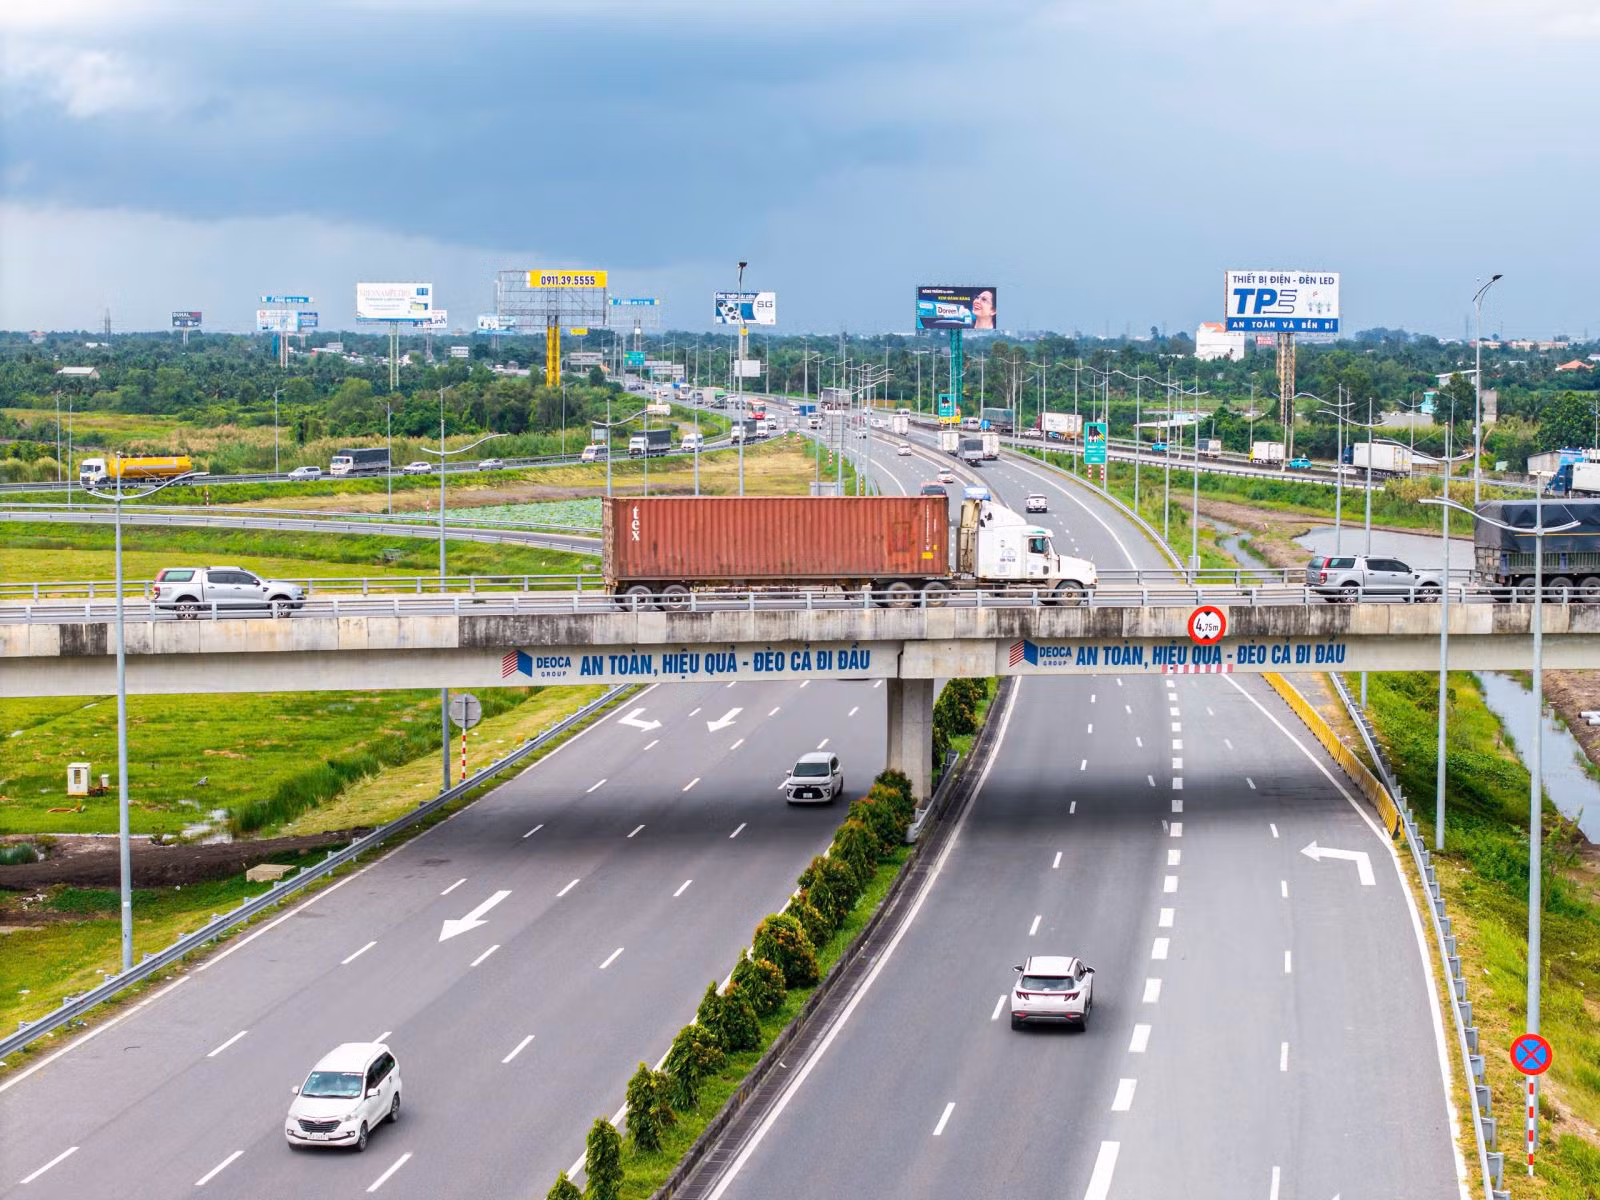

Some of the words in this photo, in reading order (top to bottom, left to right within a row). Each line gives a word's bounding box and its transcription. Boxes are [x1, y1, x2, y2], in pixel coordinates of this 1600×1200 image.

[541, 276, 595, 285] 0911.39.5555
[1233, 273, 1256, 284] THIẾT
[1259, 276, 1267, 285] BỊ
[1270, 274, 1290, 286] ĐIỆN
[1299, 275, 1316, 284] ĐÈN
[632, 505, 640, 541] tex
[1196, 618, 1218, 632] 4,75m
[1039, 647, 1072, 658] DEOCA
[1076, 646, 1098, 665] AN
[1103, 641, 1148, 669] TOÀN,
[1152, 640, 1187, 670] HIỆU
[1237, 640, 1266, 664] ĐÈO
[1271, 638, 1291, 664] CẢ
[1296, 644, 1310, 663] ĐI
[1315, 636, 1345, 663] ĐẦU
[536, 656, 571, 669] DEOCA
[580, 655, 604, 676] AN
[608, 649, 658, 677] TOÀN,
[663, 648, 699, 679] HIỆU
[704, 644, 737, 674] QUẢ
[754, 646, 785, 672] ĐÈO
[790, 644, 813, 672] CẢ
[817, 650, 833, 671] ĐI
[838, 642, 870, 670] ĐẦU
